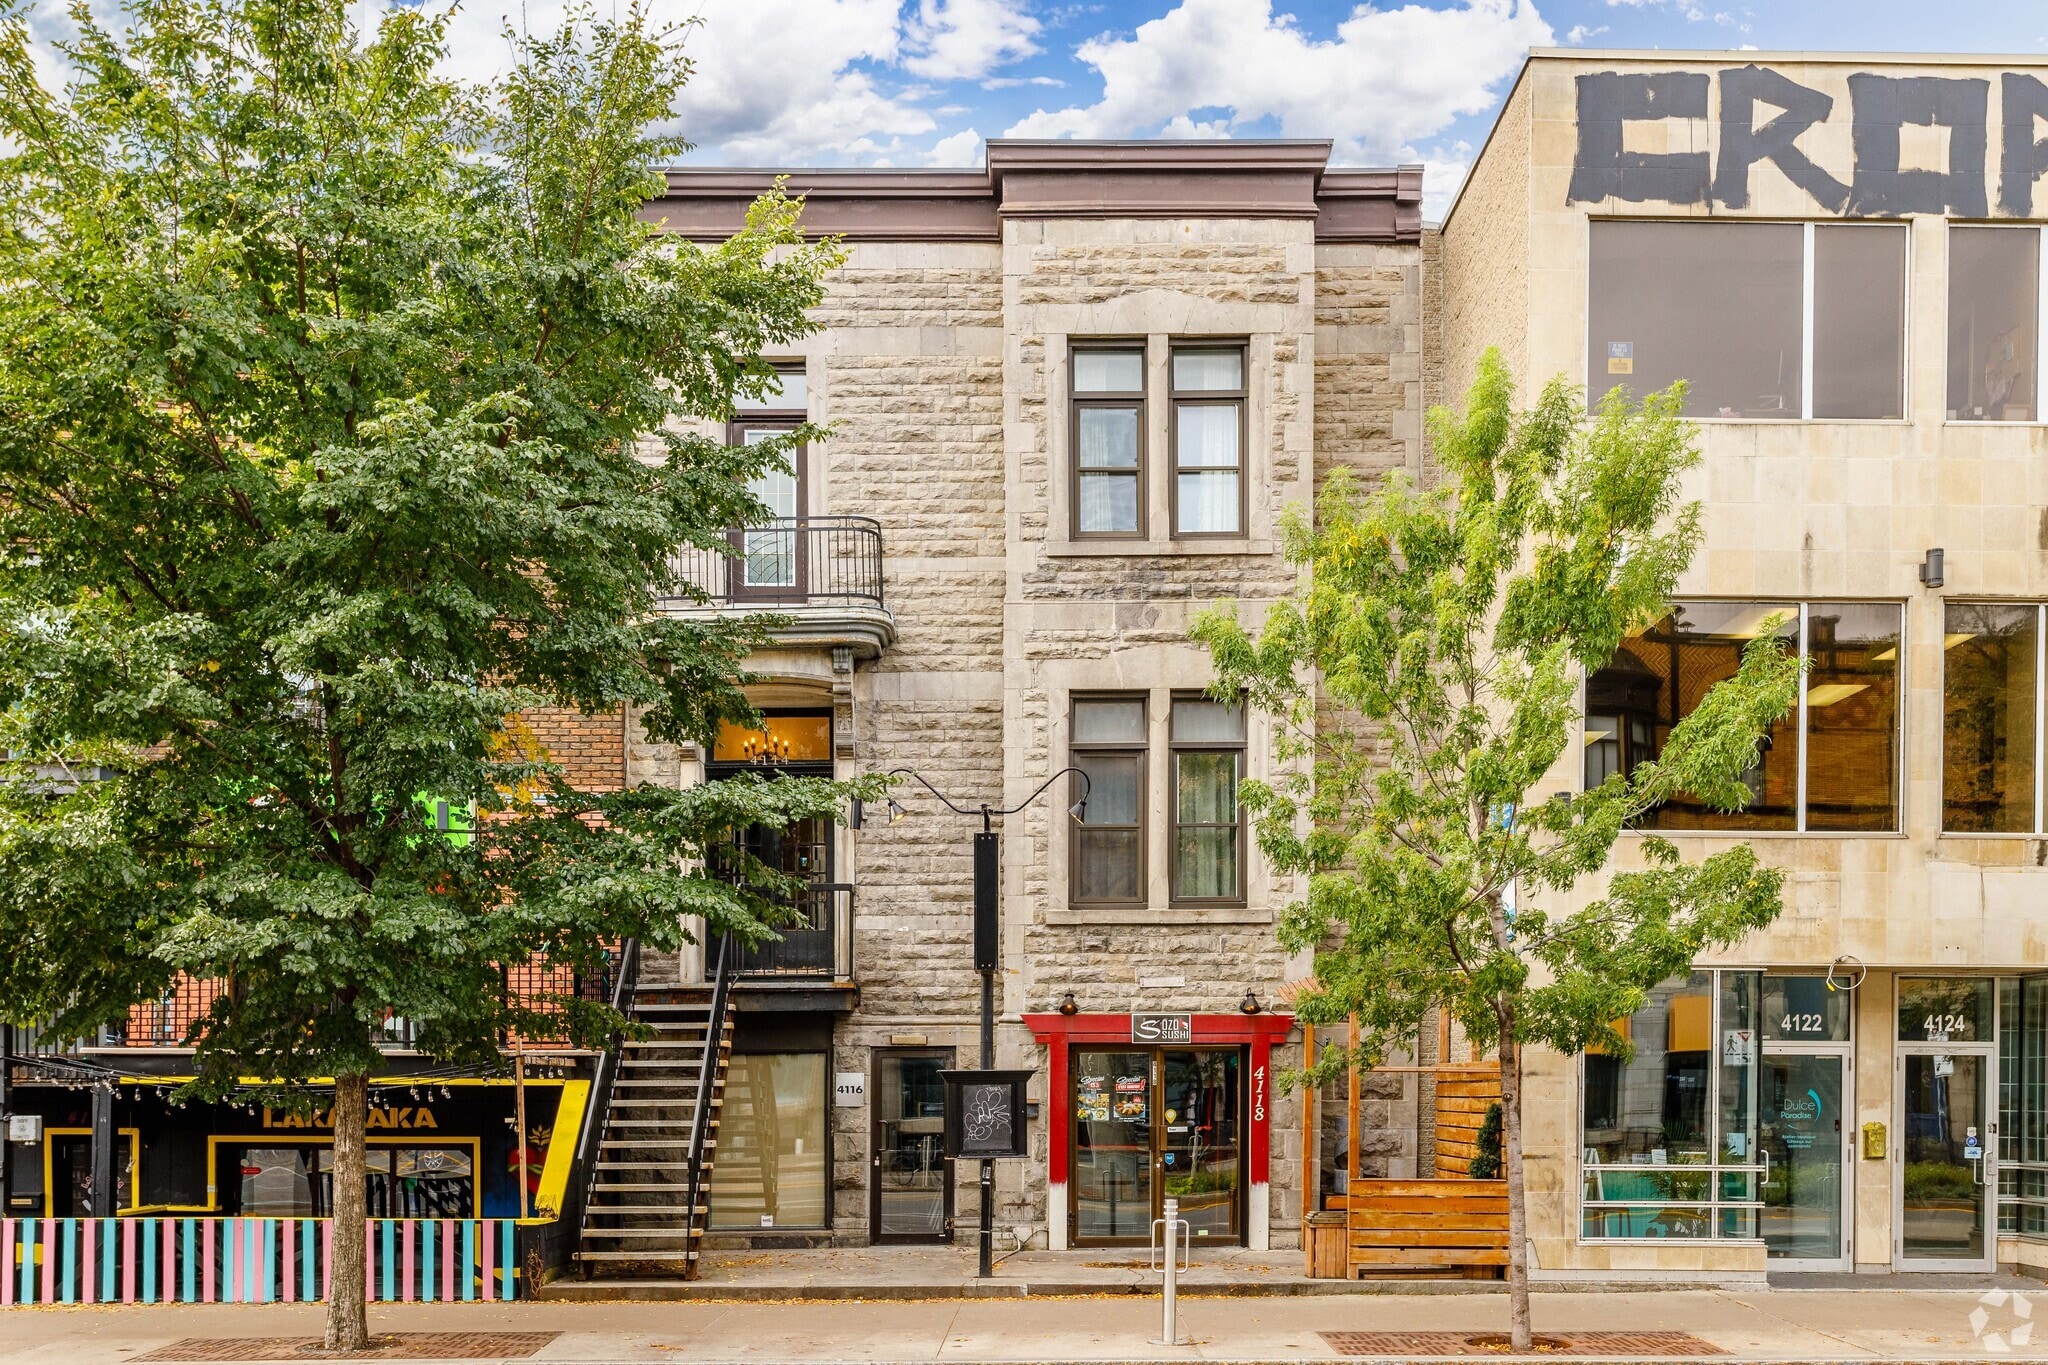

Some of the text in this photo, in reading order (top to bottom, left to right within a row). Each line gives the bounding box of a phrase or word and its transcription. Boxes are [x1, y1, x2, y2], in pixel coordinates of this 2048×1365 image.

[750, 755, 789, 765] 4114
[1781, 1014, 1822, 1031] 4122
[1923, 1014, 1965, 1032] 4124
[1162, 1031, 1189, 1039] SUSHI
[837, 1085, 863, 1094] 4116
[1254, 1066, 1265, 1121] 4118
[1784, 1098, 1816, 1111] Dulce
[263, 1107, 438, 1128] LAKAKA
[1780, 1111, 1812, 1119] Paradise
